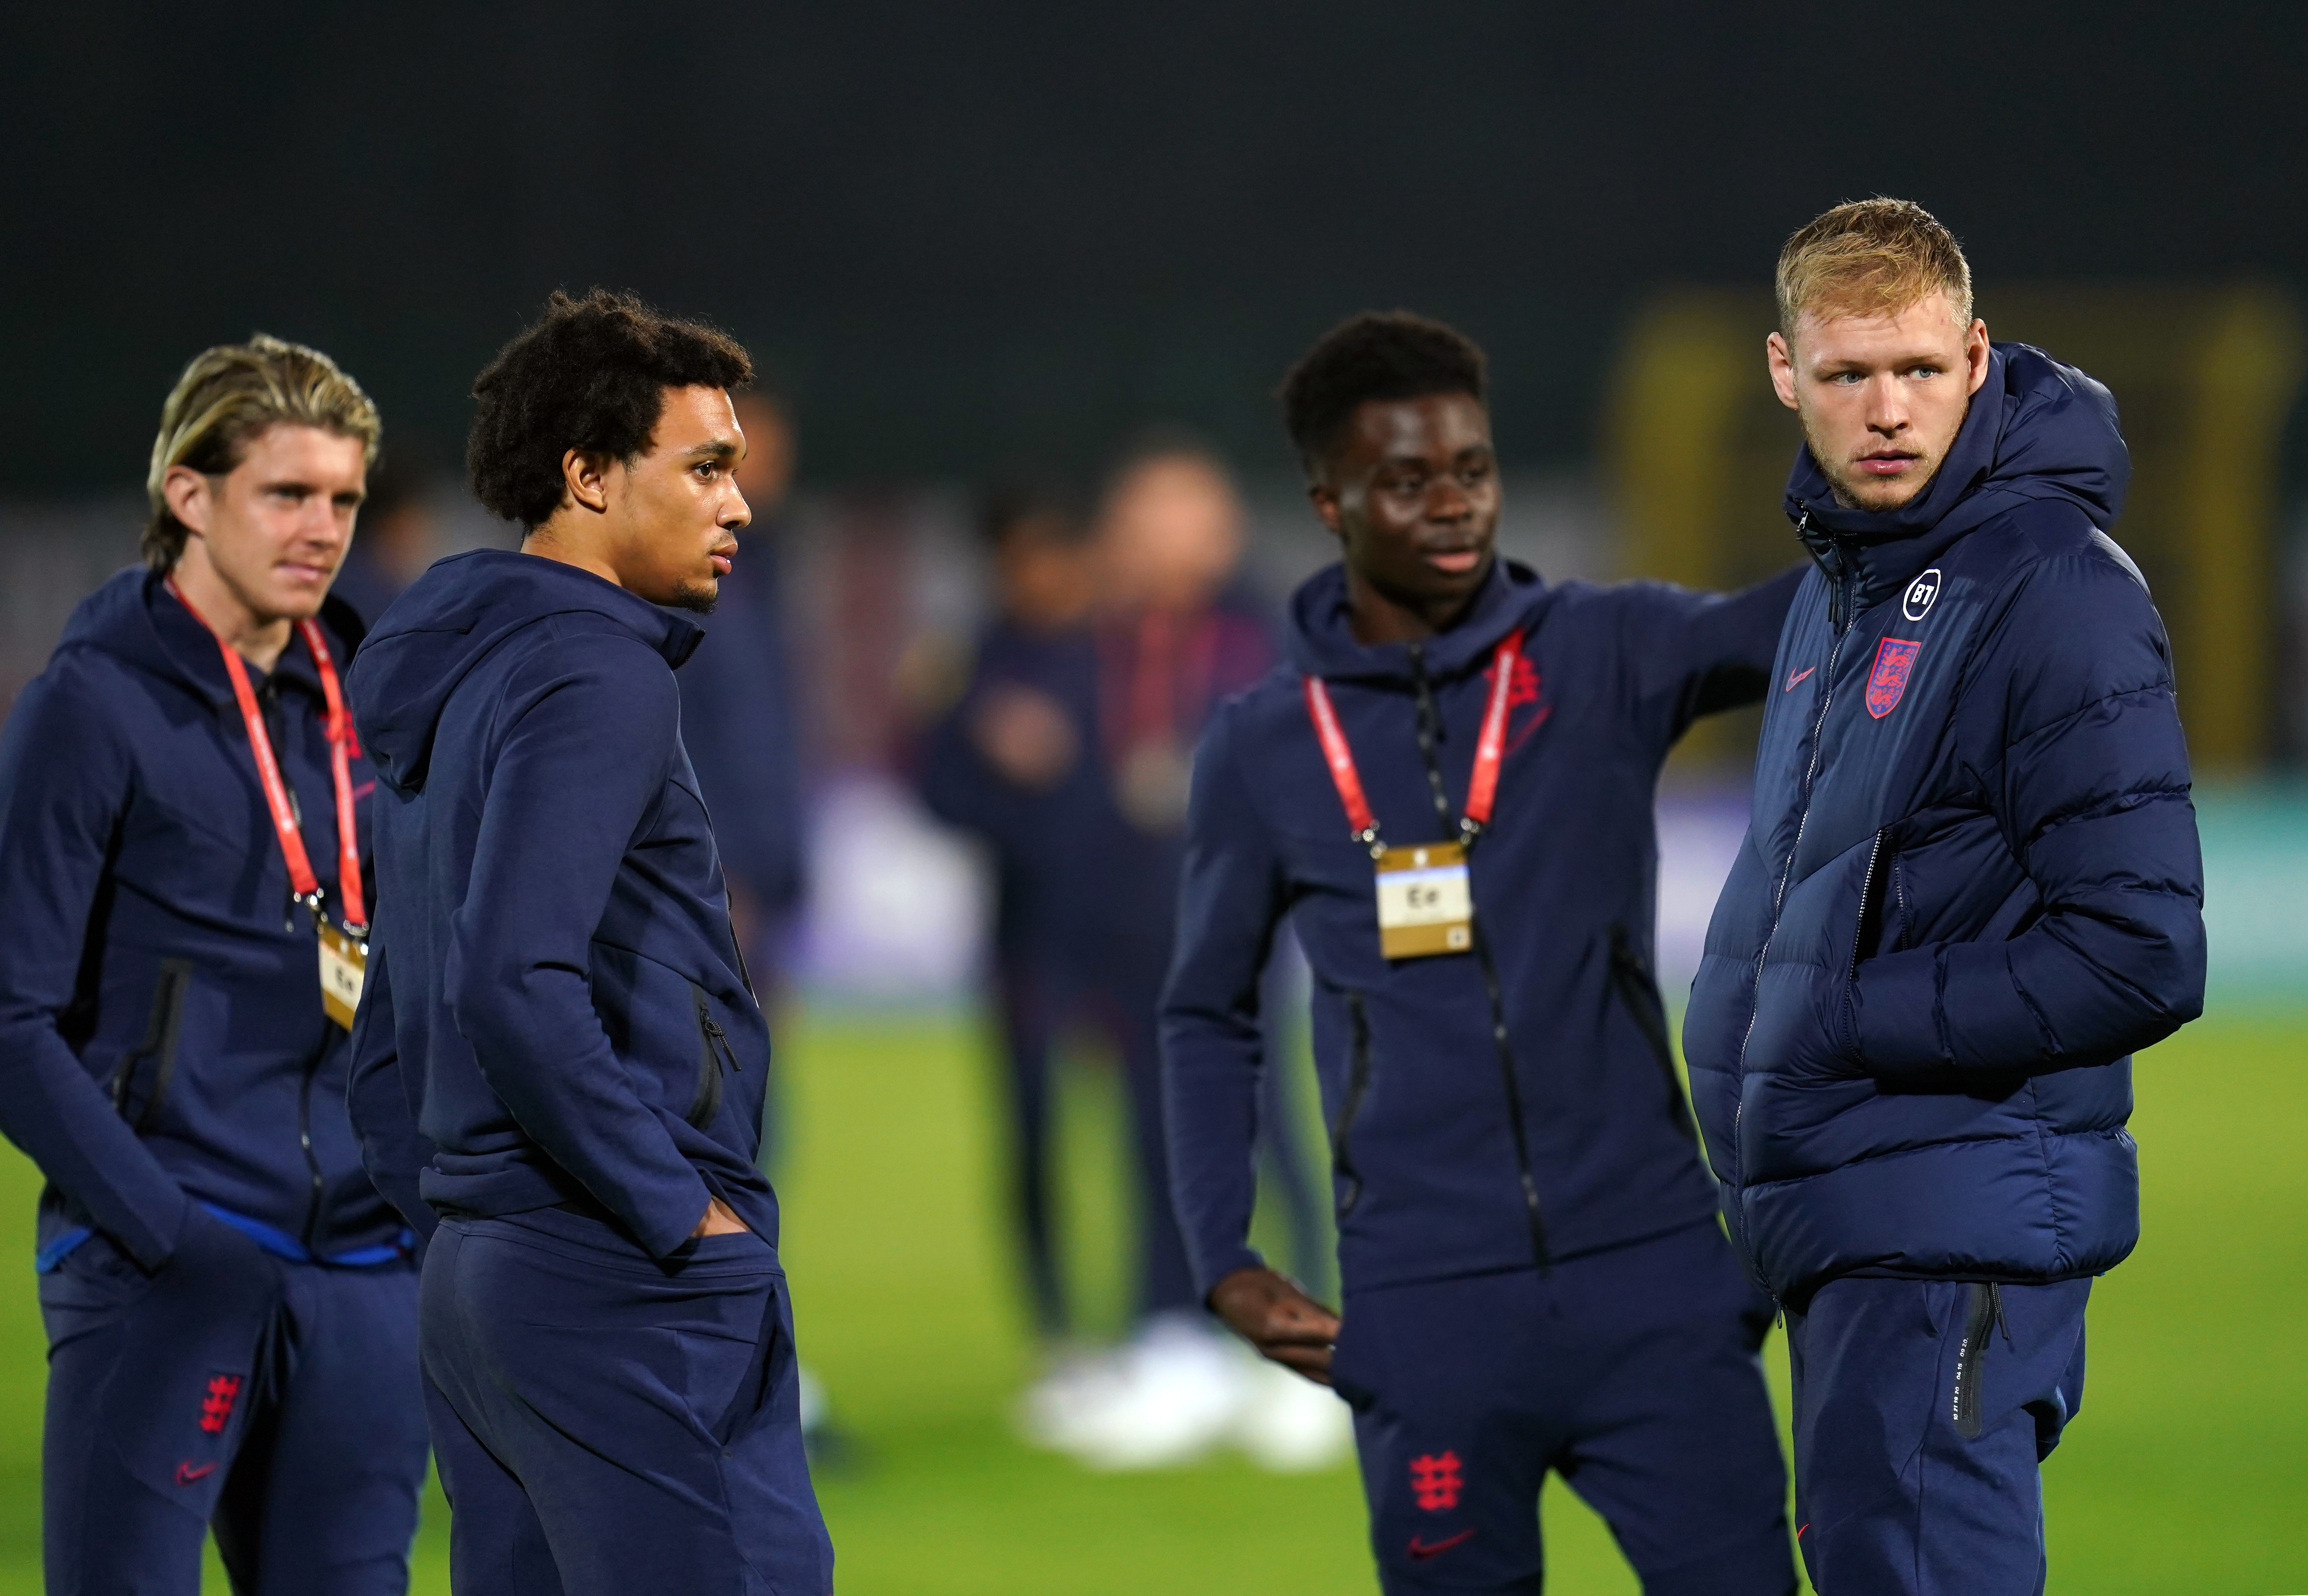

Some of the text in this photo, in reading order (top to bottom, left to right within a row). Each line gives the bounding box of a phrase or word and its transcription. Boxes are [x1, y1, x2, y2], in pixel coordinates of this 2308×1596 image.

[1911, 583, 1934, 605] BT
[1960, 1348, 1966, 1357] 09
[1956, 1371, 1961, 1380] 04
[1955, 1386, 1959, 1395] 20
